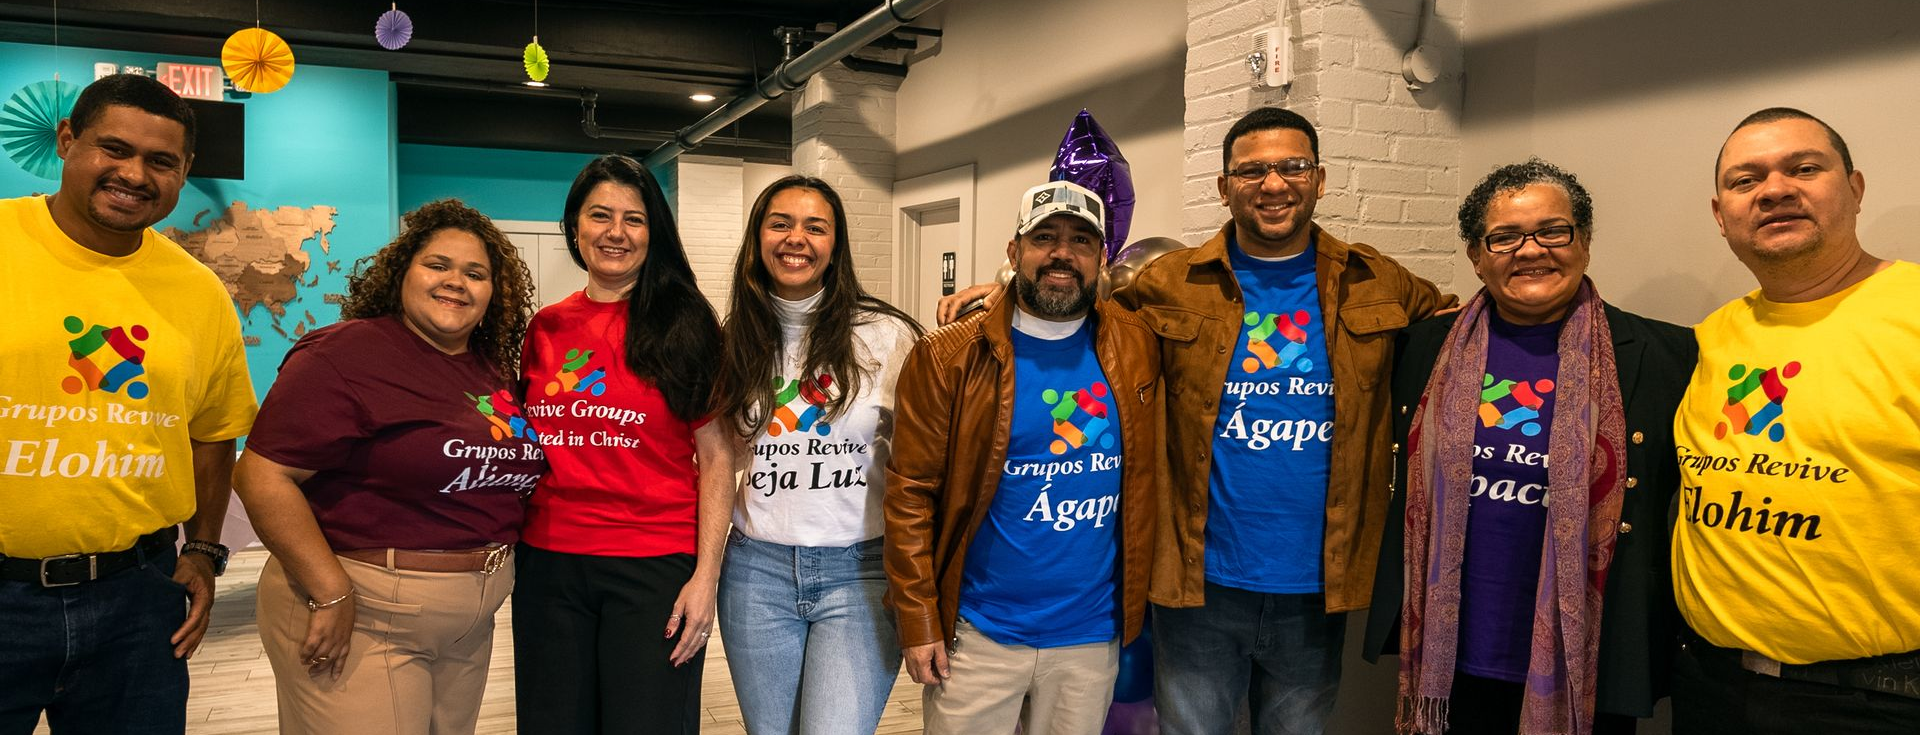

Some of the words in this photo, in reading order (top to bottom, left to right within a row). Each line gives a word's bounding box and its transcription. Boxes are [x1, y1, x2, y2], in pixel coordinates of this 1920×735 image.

[168, 64, 213, 97] EXIT
[106, 402, 180, 428] Revve
[524, 399, 566, 418] evive
[571, 399, 647, 426] Groups
[567, 430, 585, 446] in
[590, 431, 640, 448] Christ
[1220, 402, 1334, 451] Ágape
[0, 438, 165, 478] Elohim
[443, 438, 517, 464] Grupos
[805, 438, 868, 456] Revive
[1003, 459, 1084, 482] Grupos
[1744, 453, 1850, 484] Revive
[1684, 485, 1822, 541] Elohim
